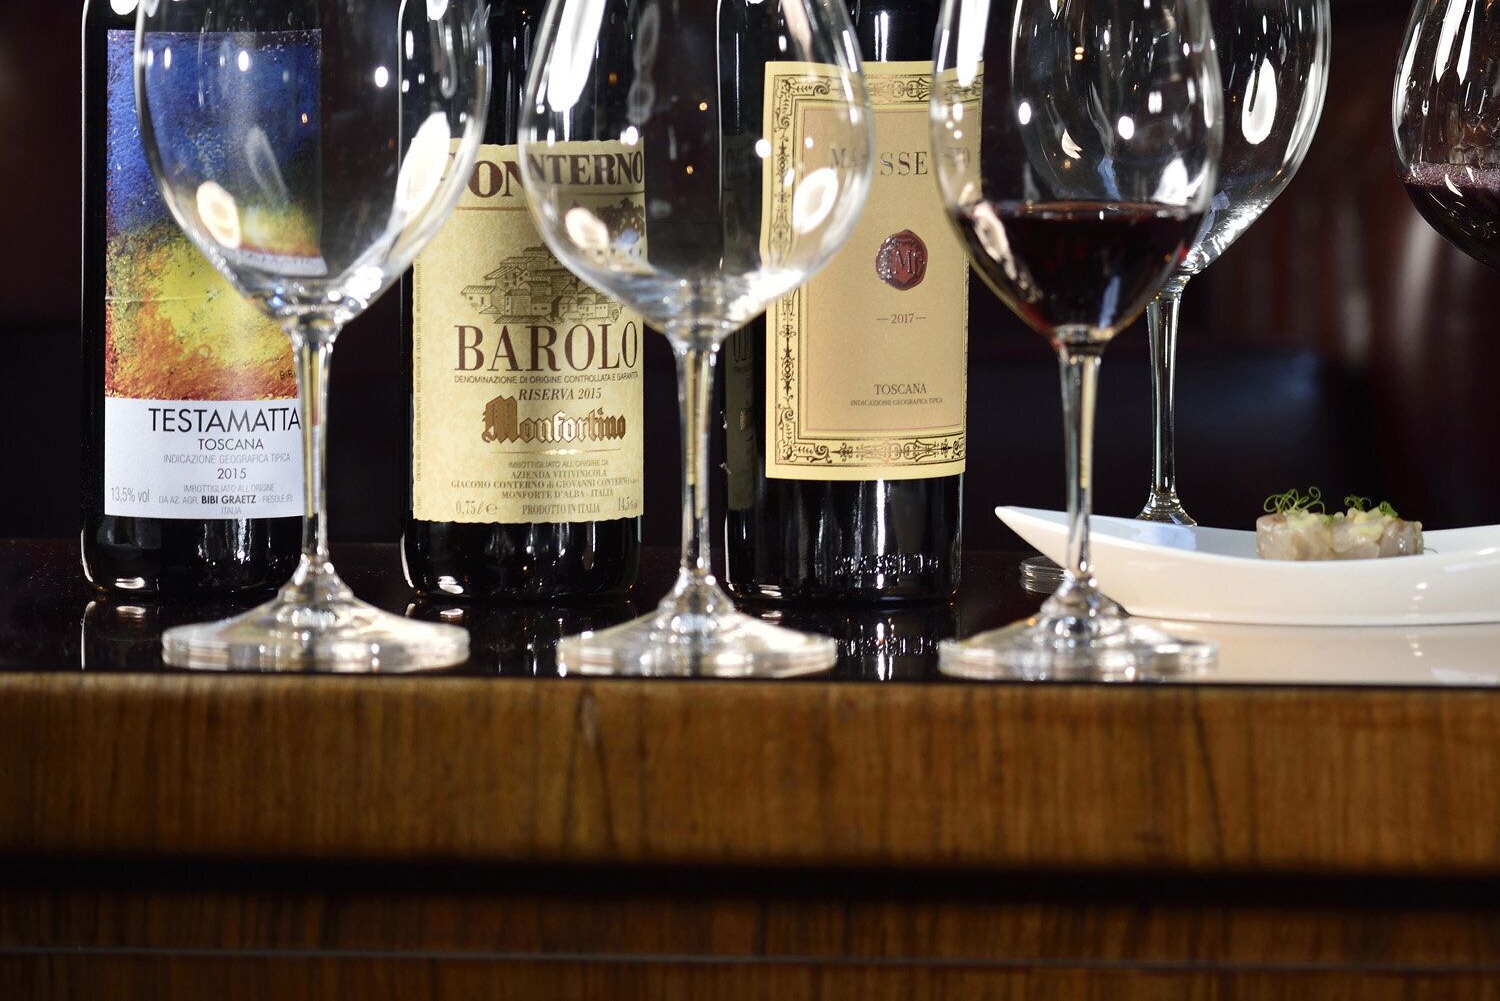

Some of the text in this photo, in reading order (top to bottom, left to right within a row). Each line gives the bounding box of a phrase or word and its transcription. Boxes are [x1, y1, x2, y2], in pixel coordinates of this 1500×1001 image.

[440, 150, 644, 199] ONTERNO
[891, 313, 915, 325] 2017
[454, 320, 638, 372] BAROLO
[454, 376, 517, 384] DENOMINAZIONE
[529, 375, 562, 383] ORIGINE
[563, 374, 611, 383] CONTROLLATA
[518, 387, 602, 401] RISERVA 2015
[874, 383, 927, 395] TOSCANA
[148, 407, 302, 433] TESTAMATTA
[482, 395, 626, 444] Monfortino
[198, 438, 264, 450] TOSCANA
[163, 453, 291, 464] INDICAZIONE GEOGRAFICA TIPICA
[217, 468, 247, 480] 2015
[511, 469, 607, 479] AZIENDA VITIVINICOLA
[183, 484, 236, 492] IMBOTTIGLIATO
[451, 480, 491, 488] GIACOMO
[493, 481, 545, 489] CONTERNO
[556, 479, 595, 488] GIOVANNI
[137, 488, 150, 503] vol
[201, 495, 219, 504] BIBI
[221, 495, 257, 504] GRAETZ
[501, 489, 614, 499] MONFORTE D'ALBA ITALIA
[221, 507, 242, 515] ITALIA
[522, 503, 600, 515] PRODOTTO IN ITALIA
